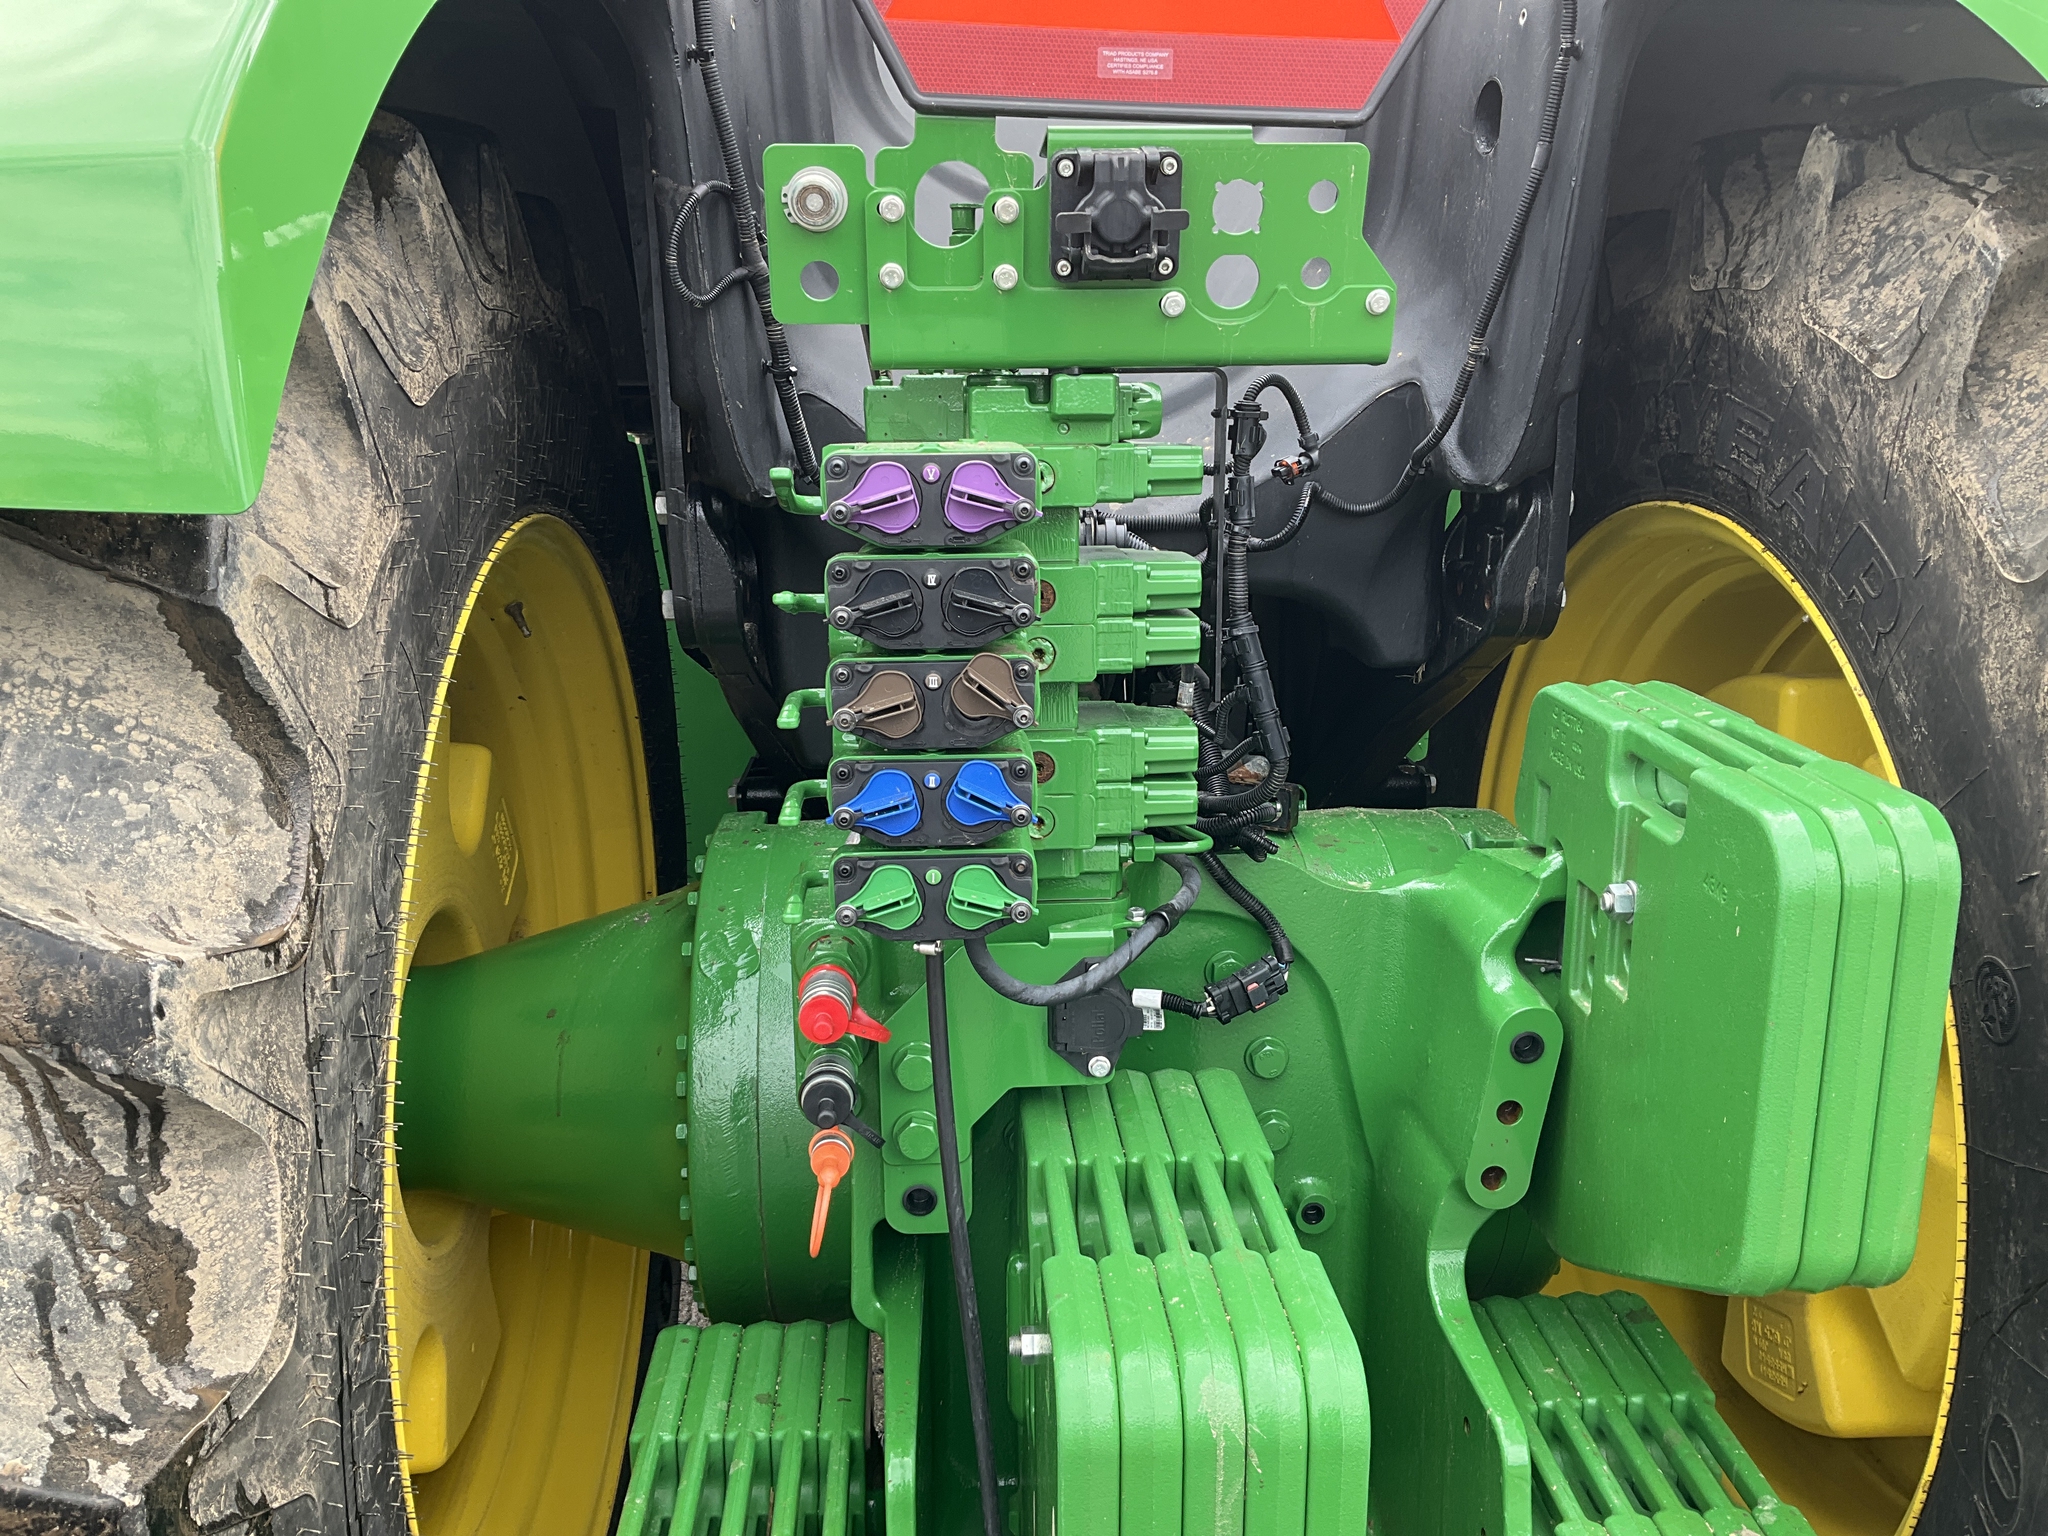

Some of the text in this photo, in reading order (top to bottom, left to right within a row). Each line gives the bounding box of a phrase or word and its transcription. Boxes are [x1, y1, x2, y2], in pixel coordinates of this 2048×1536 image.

[926, 468, 936, 480] V
[927, 574, 937, 586] IV
[928, 676, 938, 688] III
[928, 776, 936, 788] II
